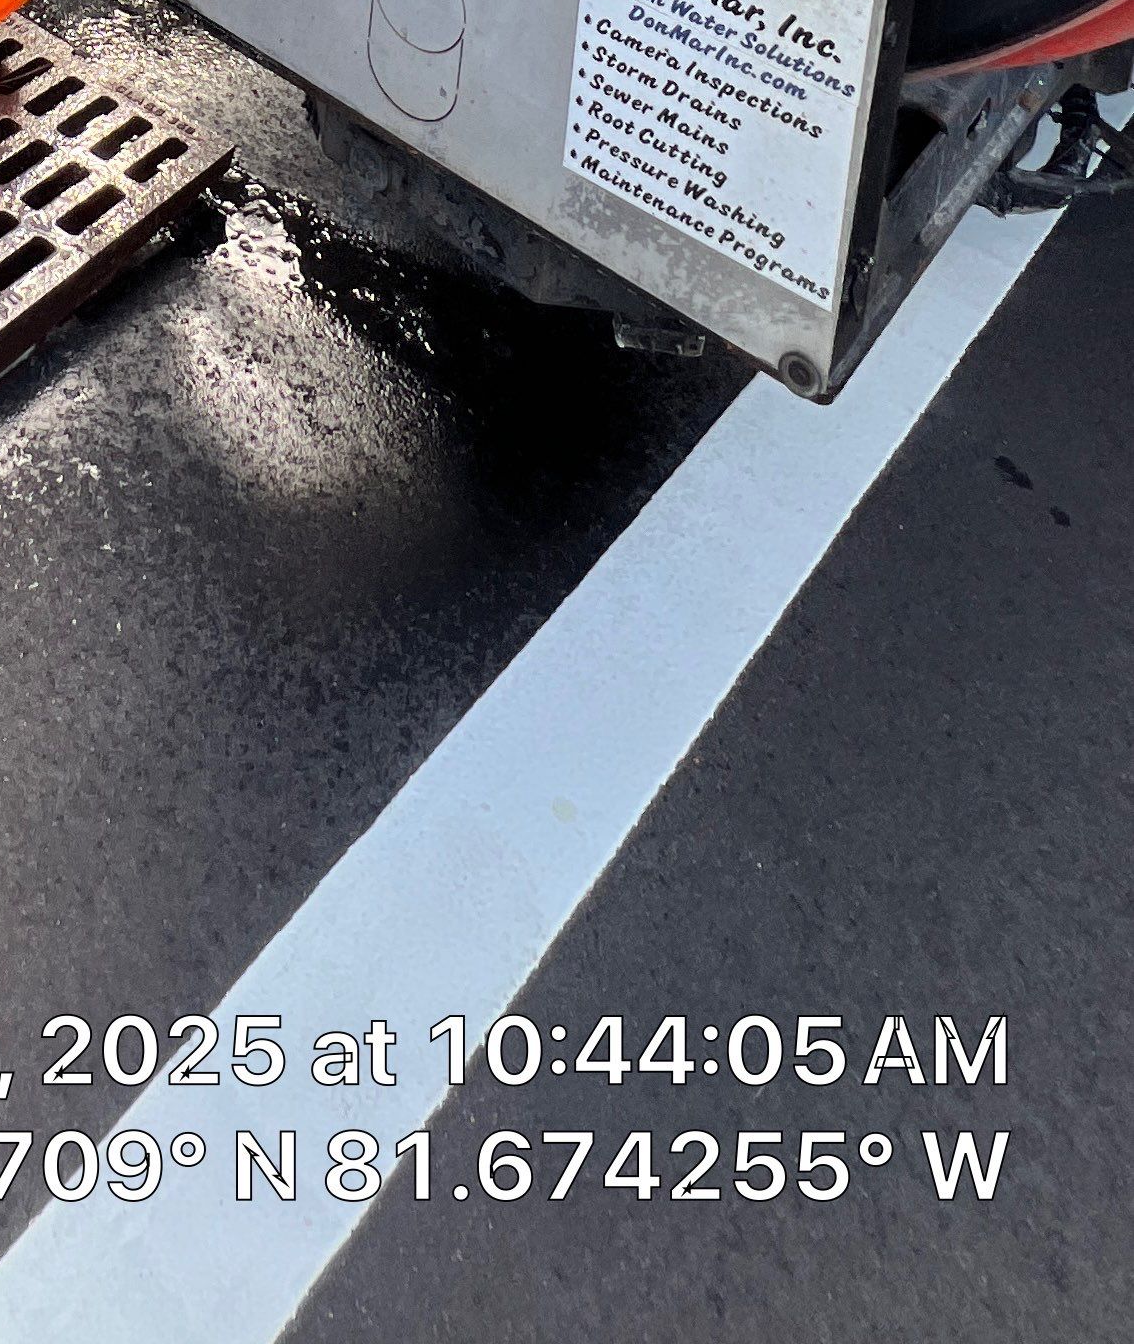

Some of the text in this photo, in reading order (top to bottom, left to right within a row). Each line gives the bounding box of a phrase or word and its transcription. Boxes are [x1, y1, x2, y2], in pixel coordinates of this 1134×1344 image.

[596, 18, 823, 139] Camera Inspections
[628, 5, 807, 101] DonMarInc.com
[739, 32, 855, 97] Solutions
[777, 14, 842, 64] Inc.
[589, 73, 729, 155] Sewer Mains
[592, 46, 742, 130] Storm Drains
[587, 100, 728, 188] Root Cutting
[581, 155, 830, 300] Maintenance Programs
[585, 128, 786, 249] Pressure Washing
